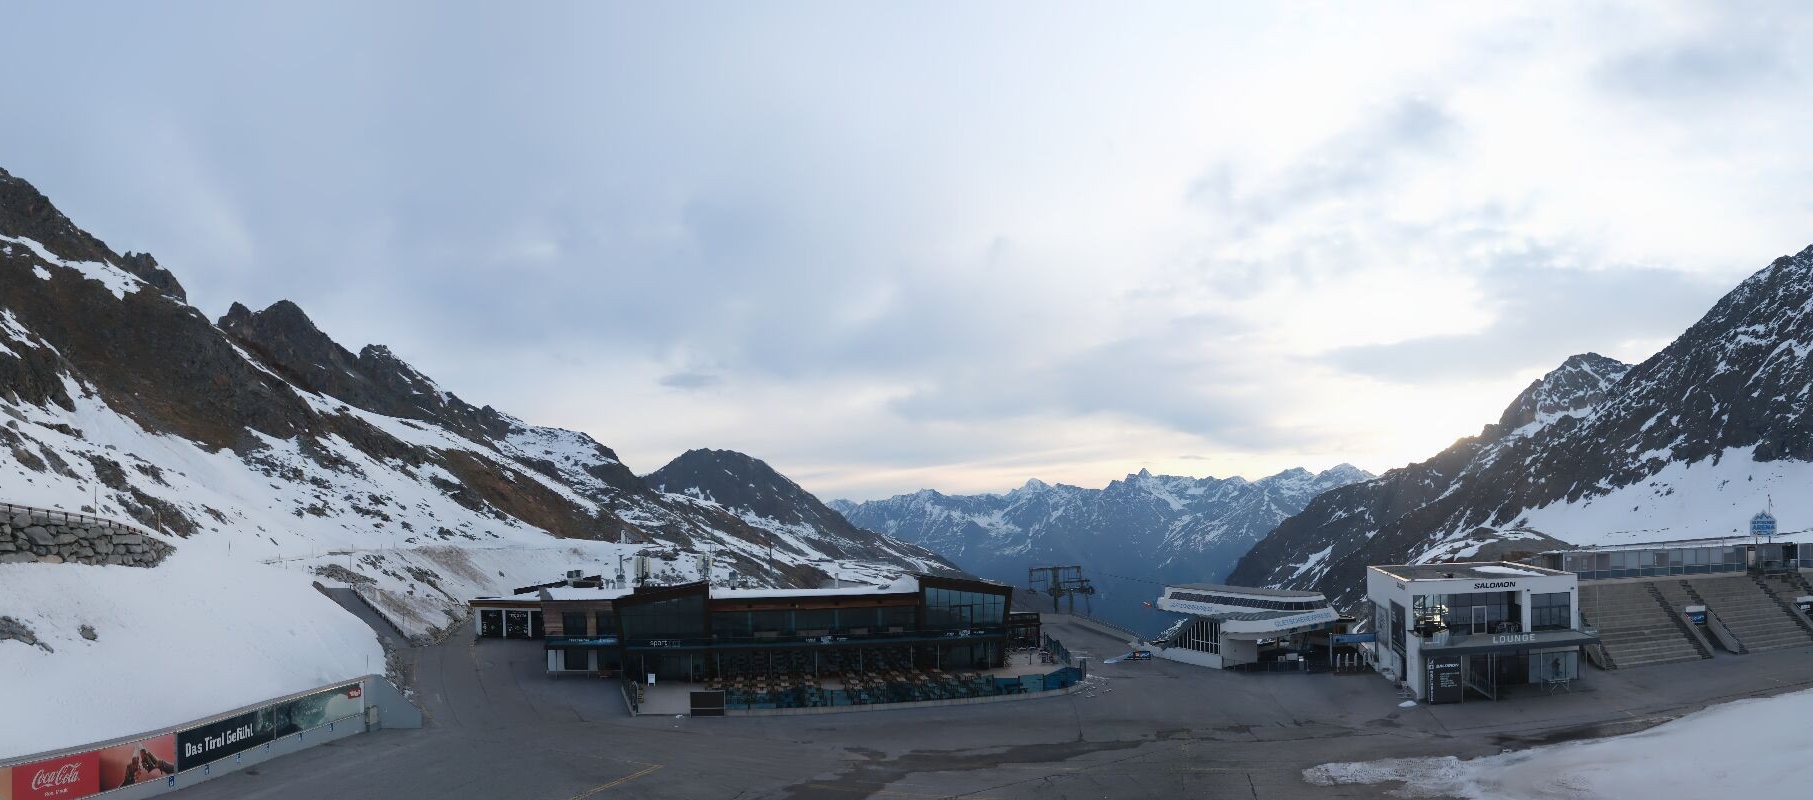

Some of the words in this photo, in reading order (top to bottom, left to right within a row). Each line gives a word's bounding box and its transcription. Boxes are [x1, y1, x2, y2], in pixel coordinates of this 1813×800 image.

[1474, 581, 1516, 589] SALOMON
[1492, 633, 1536, 644] LOUNGE
[185, 742, 203, 757] Das
[204, 736, 225, 752] Tirol
[226, 723, 254, 745] Gefühl
